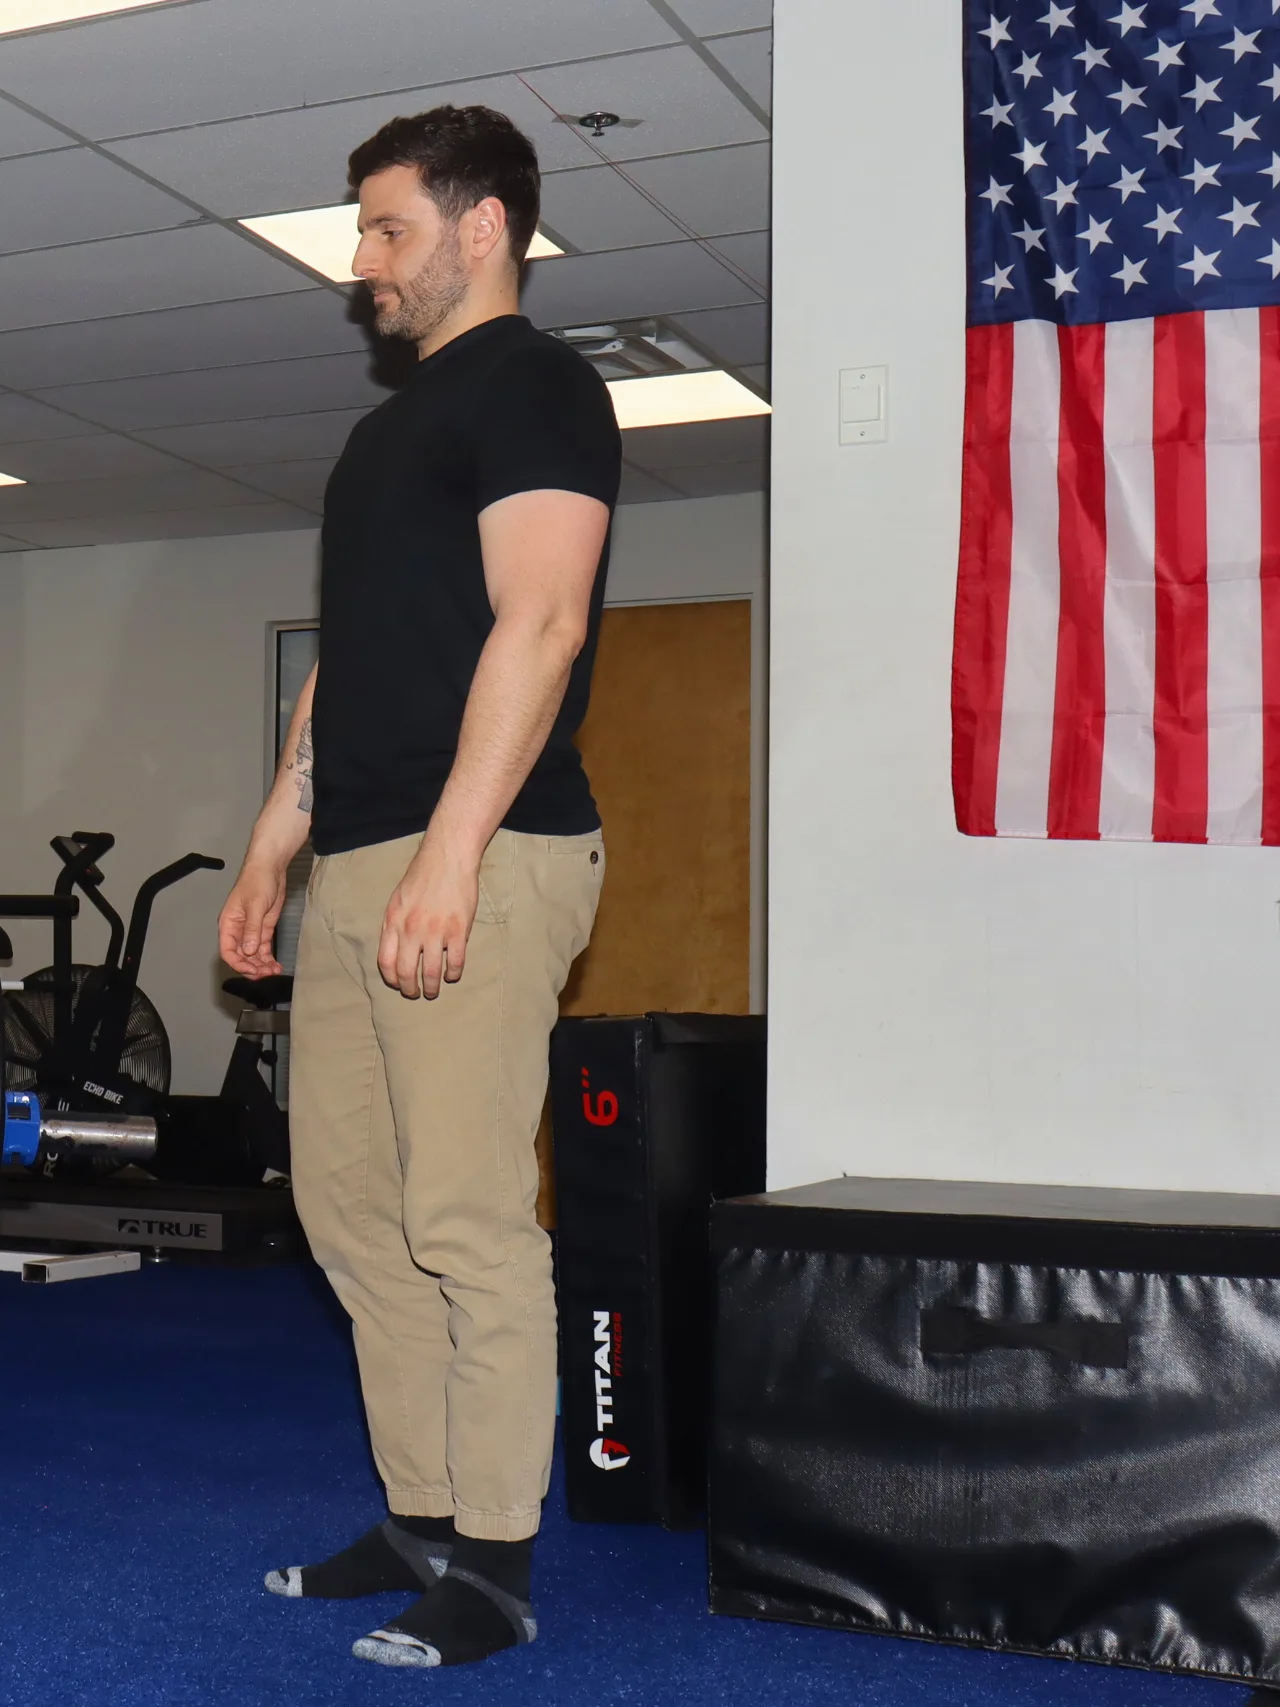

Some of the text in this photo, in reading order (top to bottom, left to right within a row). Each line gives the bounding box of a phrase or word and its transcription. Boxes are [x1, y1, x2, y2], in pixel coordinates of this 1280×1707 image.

[82, 1080, 124, 1105] ECHO BIKE
[142, 1220, 208, 1239] TRUE
[613, 1311, 624, 1377] FITNESS
[593, 1311, 613, 1432] TITAN
